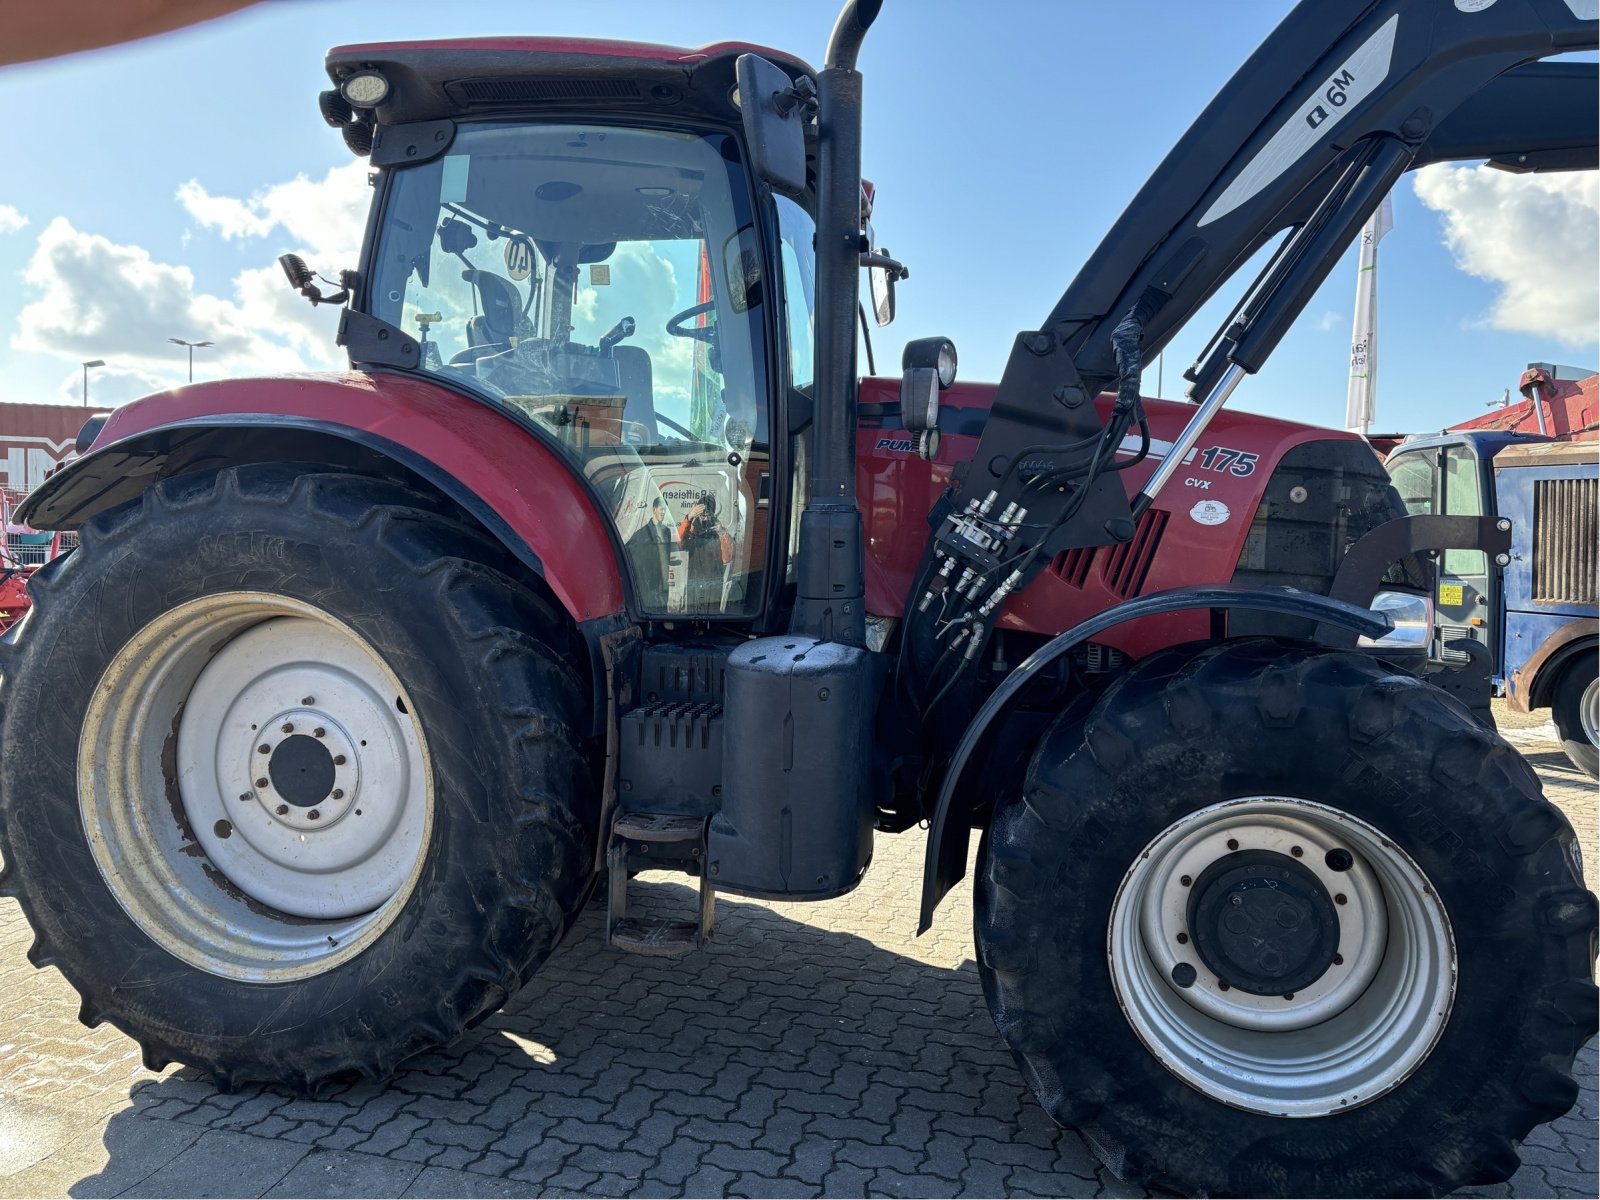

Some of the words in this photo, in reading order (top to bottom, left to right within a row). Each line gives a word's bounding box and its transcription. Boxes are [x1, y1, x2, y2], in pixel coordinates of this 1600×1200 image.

[875, 438, 915, 452] PUM
[1200, 445, 1260, 477] 175
[1184, 477, 1211, 489] CVX
